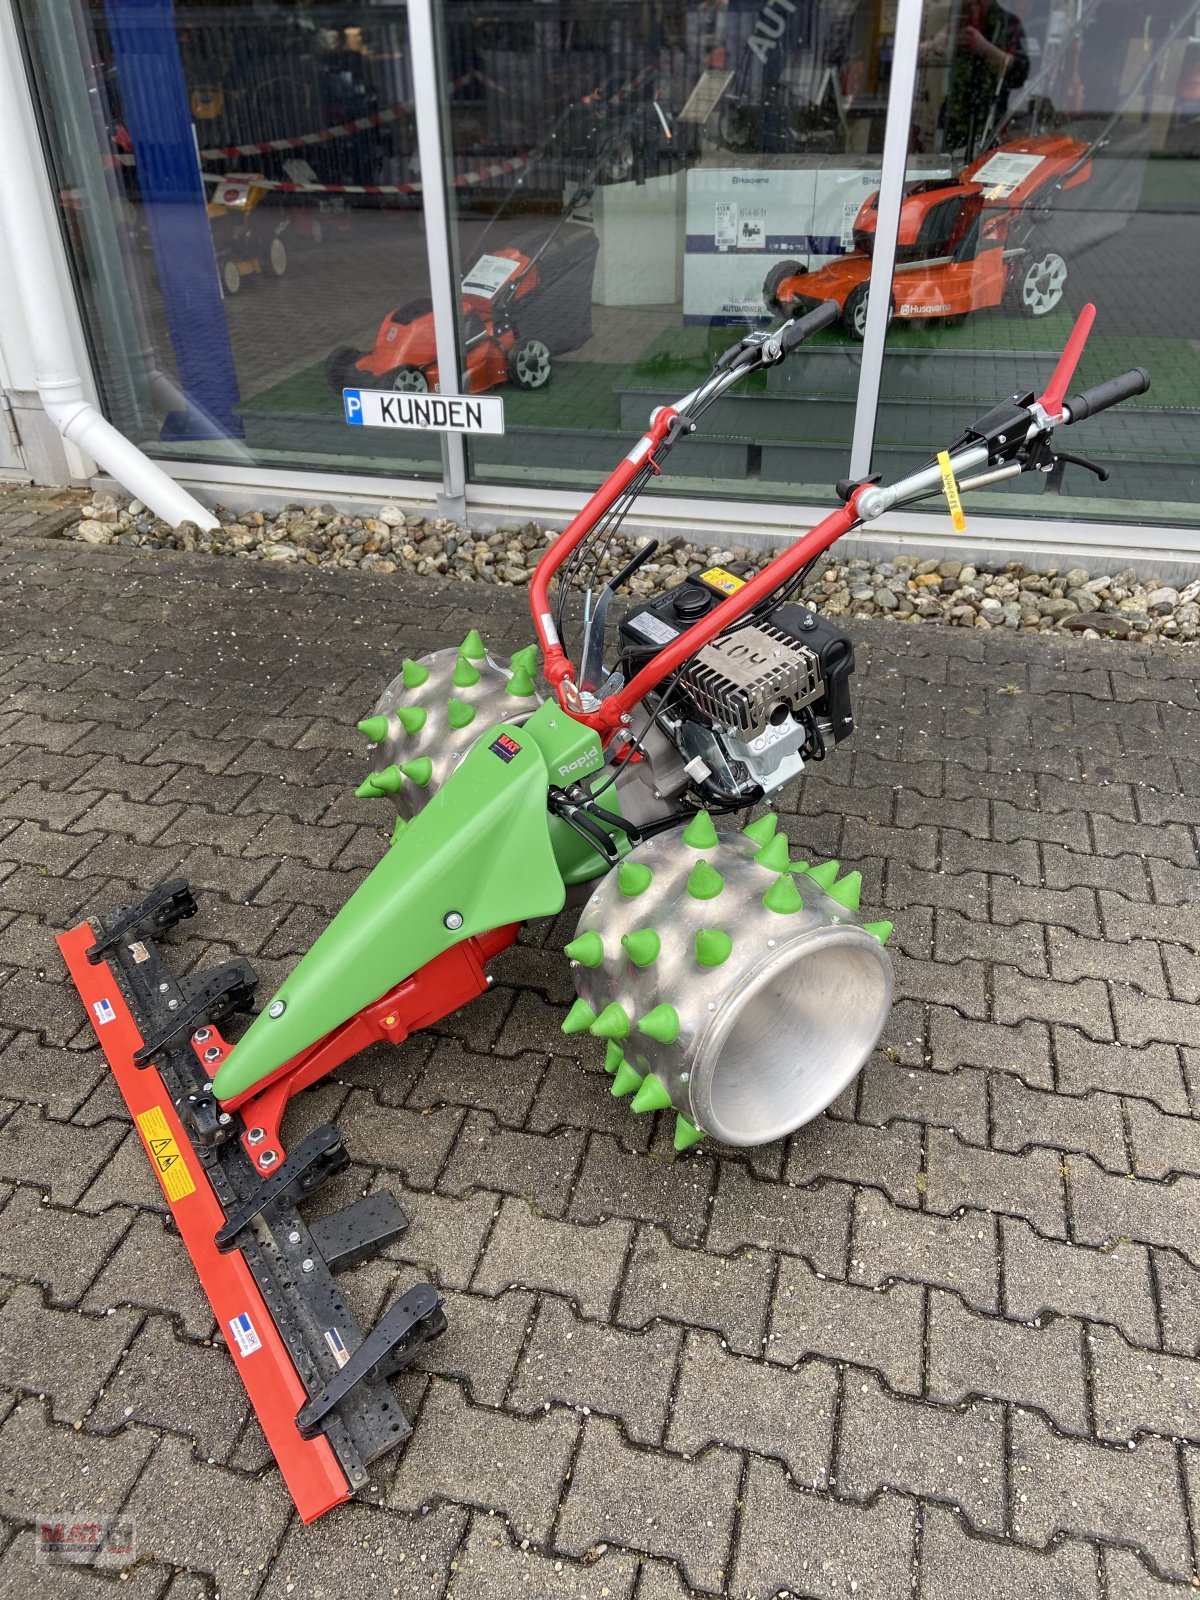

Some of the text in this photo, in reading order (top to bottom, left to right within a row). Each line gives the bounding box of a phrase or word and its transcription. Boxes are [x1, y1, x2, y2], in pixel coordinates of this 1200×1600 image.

[910, 304, 952, 314] Husqvarna
[347, 396, 482, 428] P KUNDEN
[710, 636, 767, 670] HOT
[498, 734, 521, 753] MAT
[558, 746, 599, 777] Rapid
[586, 758, 600, 769] REX
